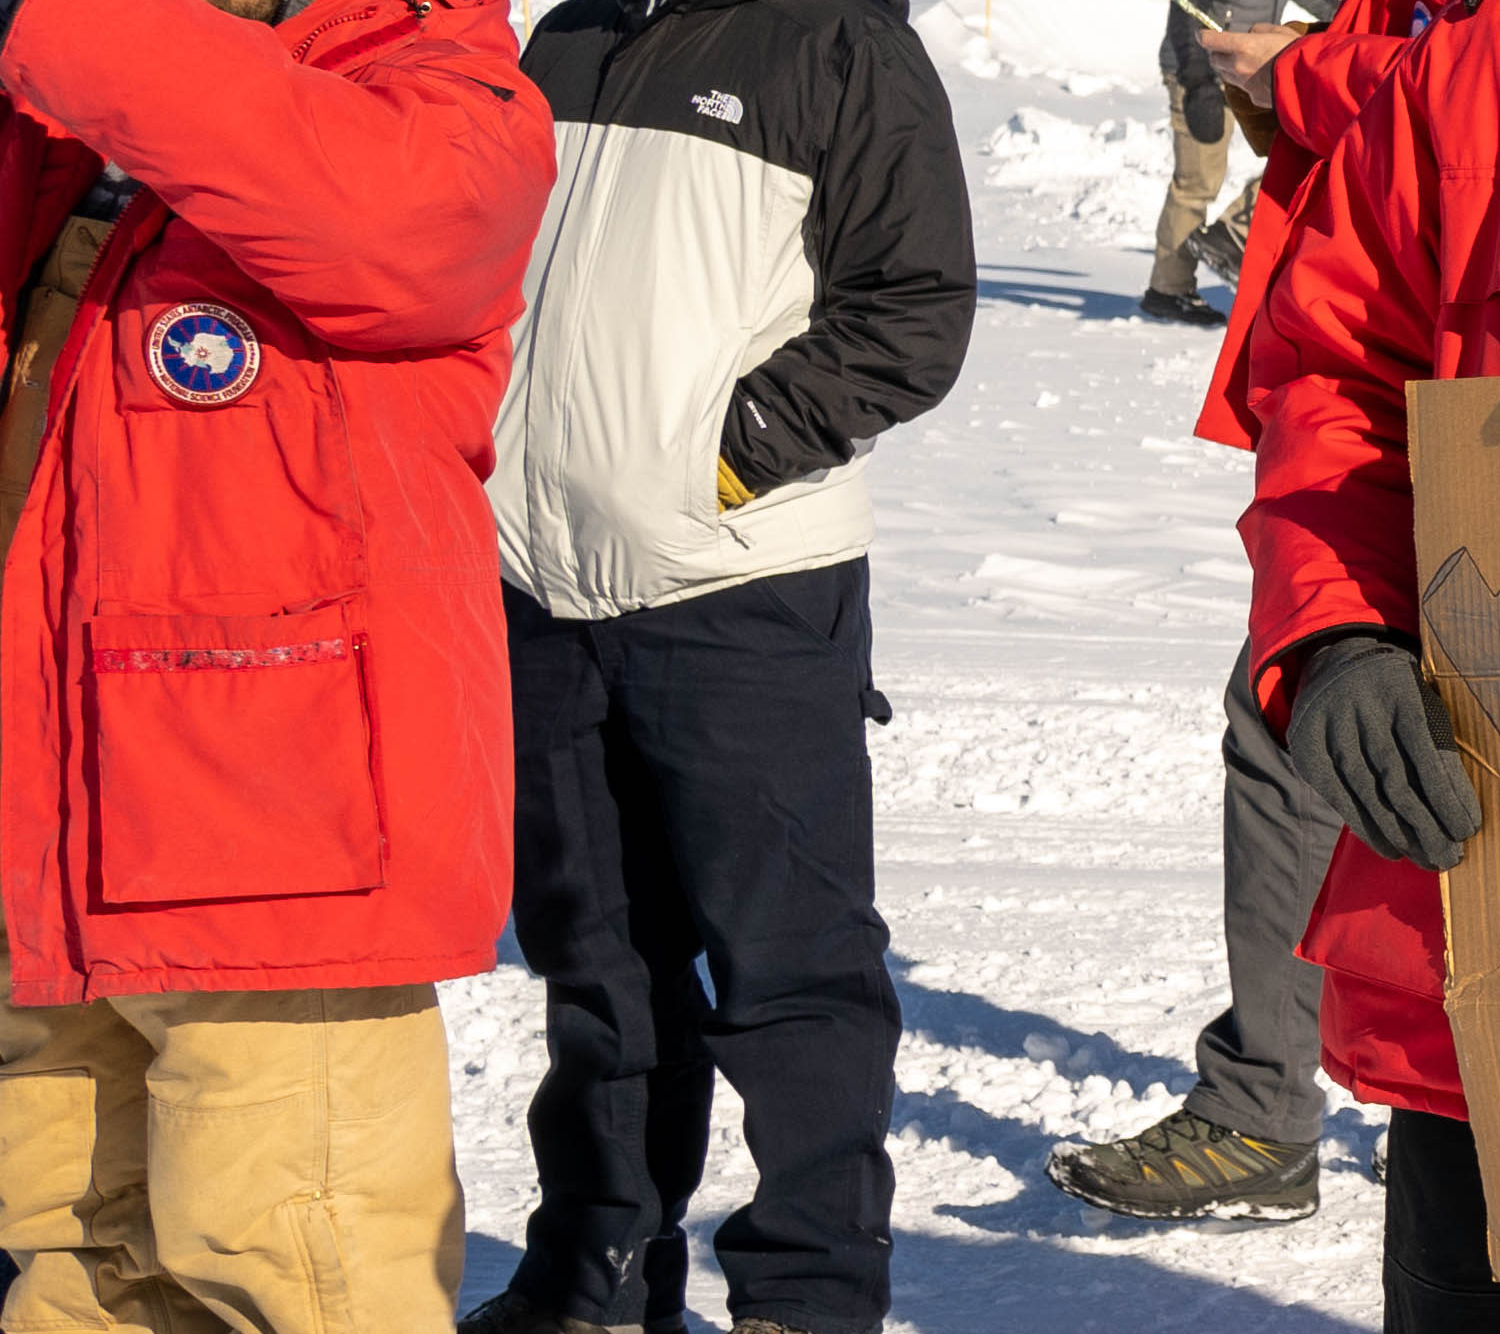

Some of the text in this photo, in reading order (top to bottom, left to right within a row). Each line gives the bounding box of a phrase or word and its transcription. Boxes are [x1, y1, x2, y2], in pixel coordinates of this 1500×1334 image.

[691, 94, 727, 111] NORTH
[710, 90, 730, 102] THE
[697, 105, 724, 119] FACE
